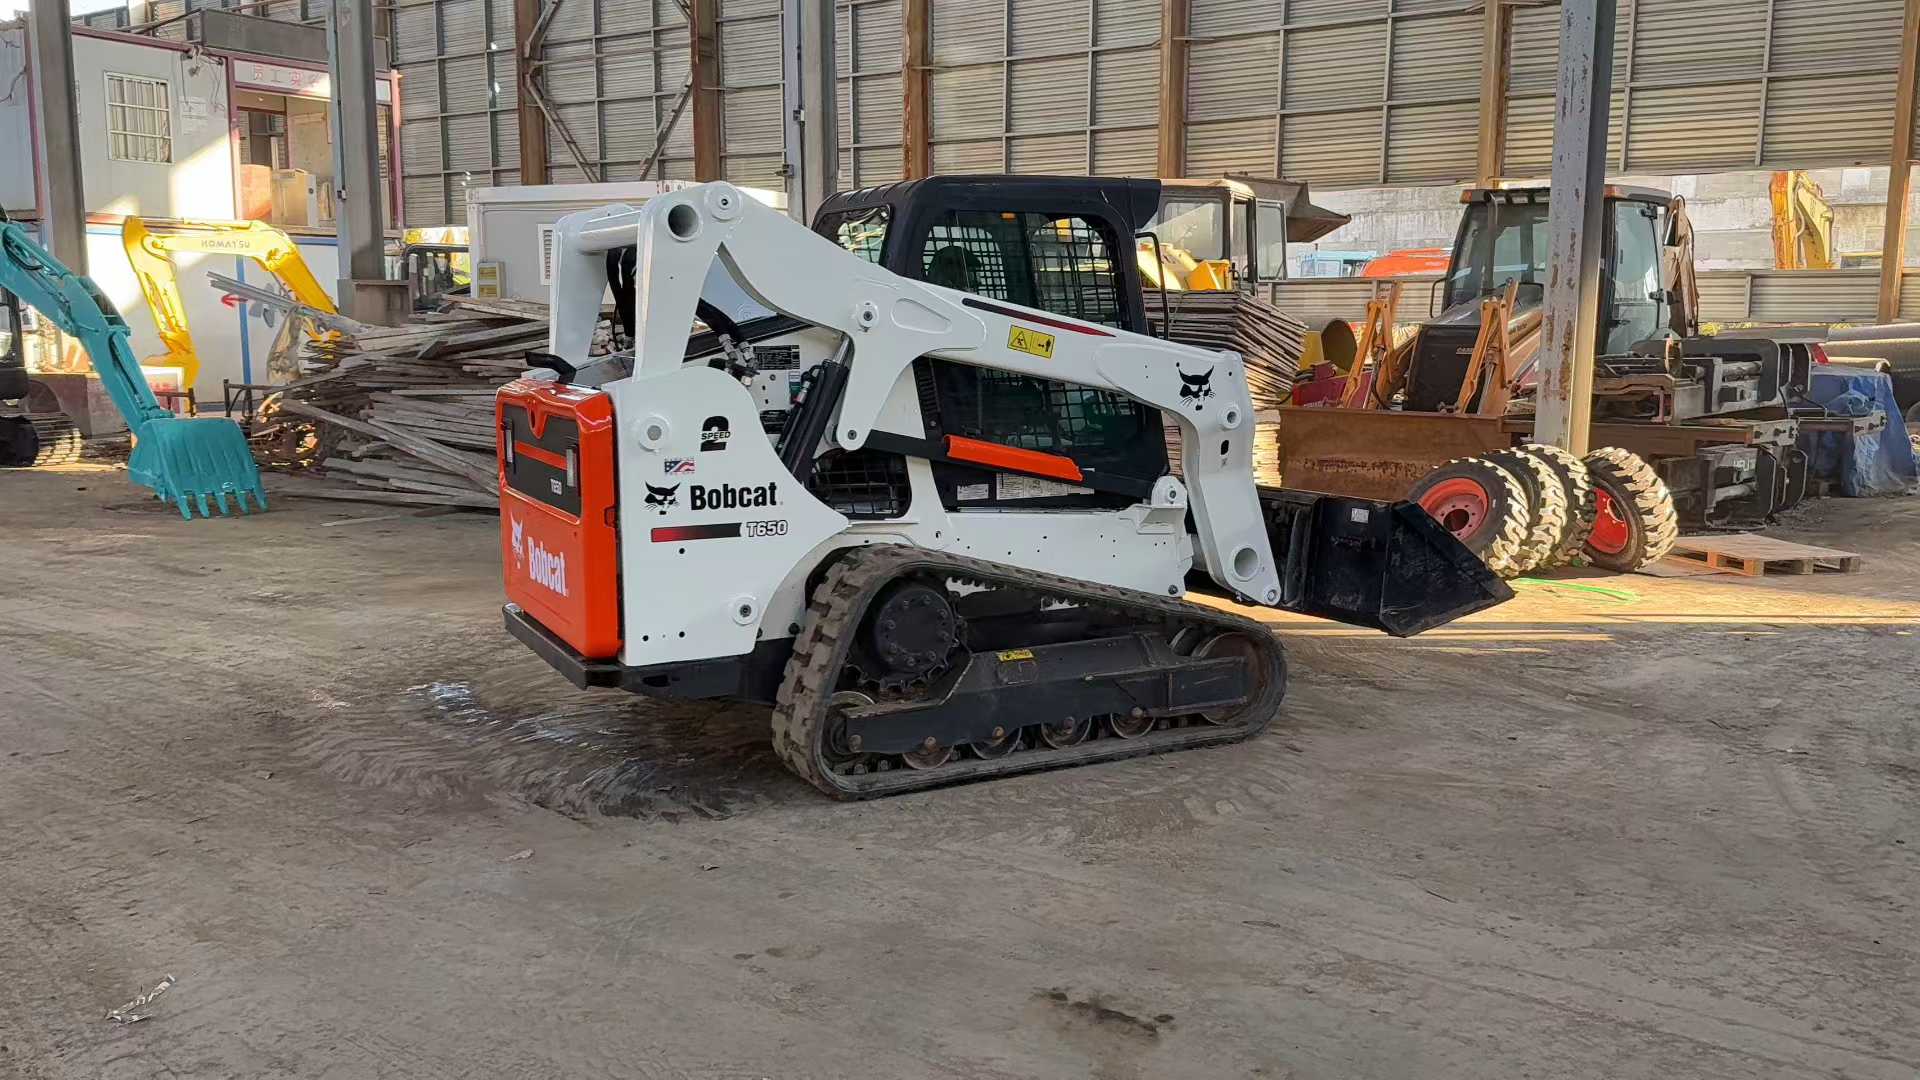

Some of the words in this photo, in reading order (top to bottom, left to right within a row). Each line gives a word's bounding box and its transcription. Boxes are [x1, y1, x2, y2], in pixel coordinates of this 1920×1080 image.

[201, 239, 250, 249] KOMATSU
[700, 415, 729, 452] 2
[701, 431, 731, 440] SPEED
[690, 482, 777, 511] Bobcat
[746, 519, 788, 537] T650
[528, 536, 566, 597] Bobcat
